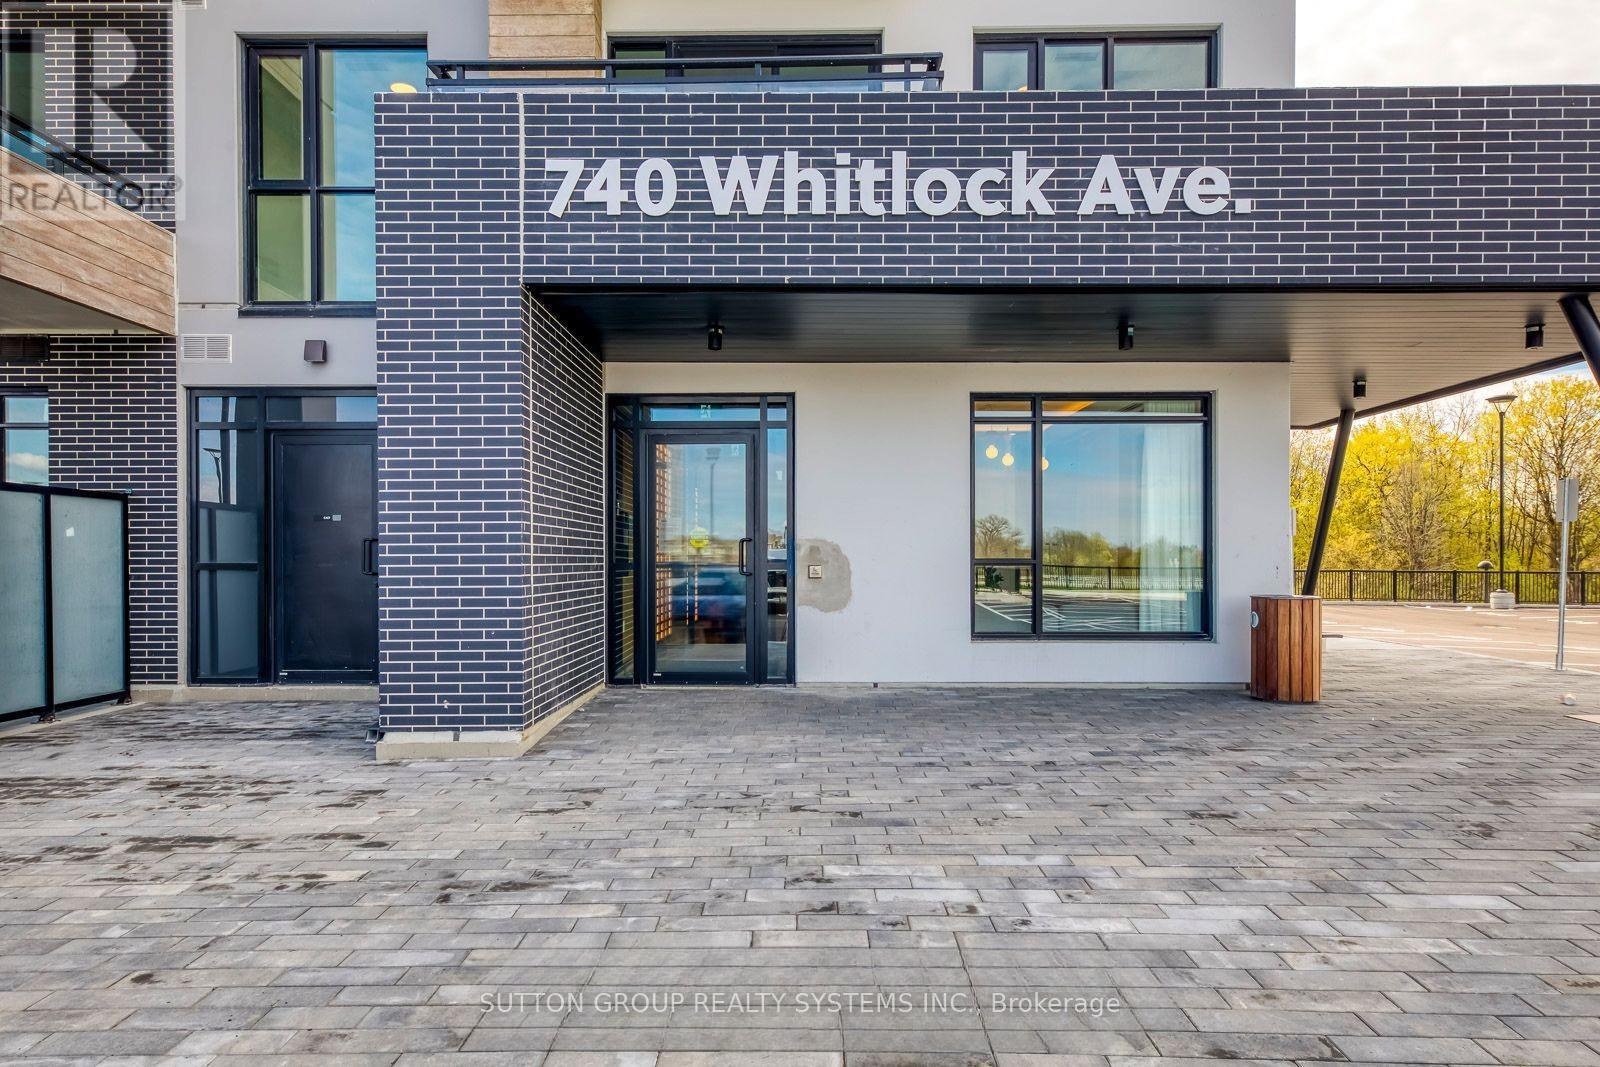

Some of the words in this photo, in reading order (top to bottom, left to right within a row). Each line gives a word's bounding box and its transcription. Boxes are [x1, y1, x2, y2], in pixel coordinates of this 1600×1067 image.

[544, 157, 679, 218] 740
[699, 150, 1056, 217] Whitlock
[1076, 154, 1252, 216] Ave.
